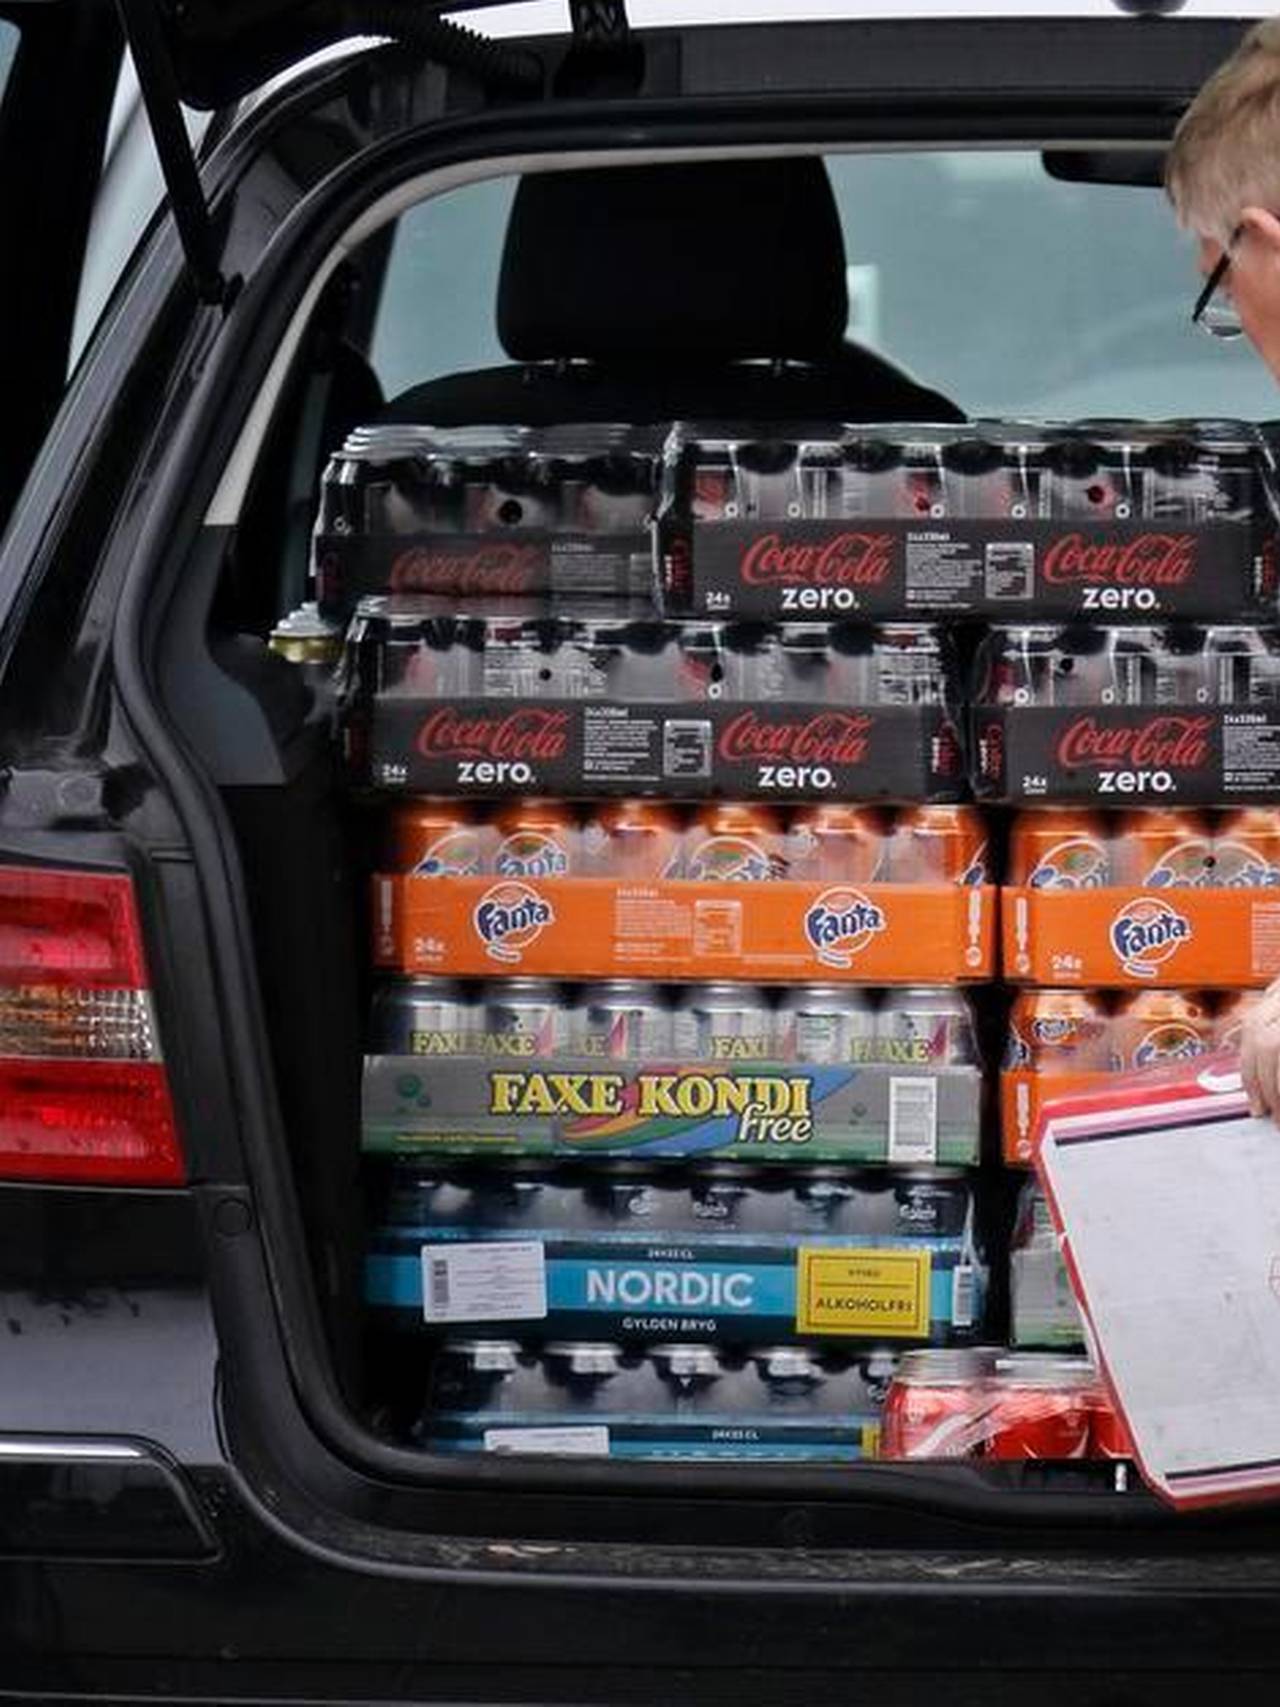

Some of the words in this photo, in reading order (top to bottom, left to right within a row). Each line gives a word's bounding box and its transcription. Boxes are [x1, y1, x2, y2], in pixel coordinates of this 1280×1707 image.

[741, 533, 896, 585] Coca-Cola
[1043, 532, 1197, 584] Coca-Cola
[418, 707, 571, 760] Coca-Cola
[718, 708, 873, 762] Coca-Cola
[1058, 715, 1215, 768] Coca-Cola
[474, 898, 555, 944] Fanta
[805, 902, 886, 948] Fanta
[1111, 912, 1190, 958] Fanta
[489, 1071, 625, 1115] FAXE
[638, 1075, 814, 1119] KONDI
[736, 1102, 815, 1144] free
[586, 1268, 755, 1307] NORDIC
[622, 1316, 678, 1331] GYLDEN
[680, 1317, 717, 1332] BRYG
